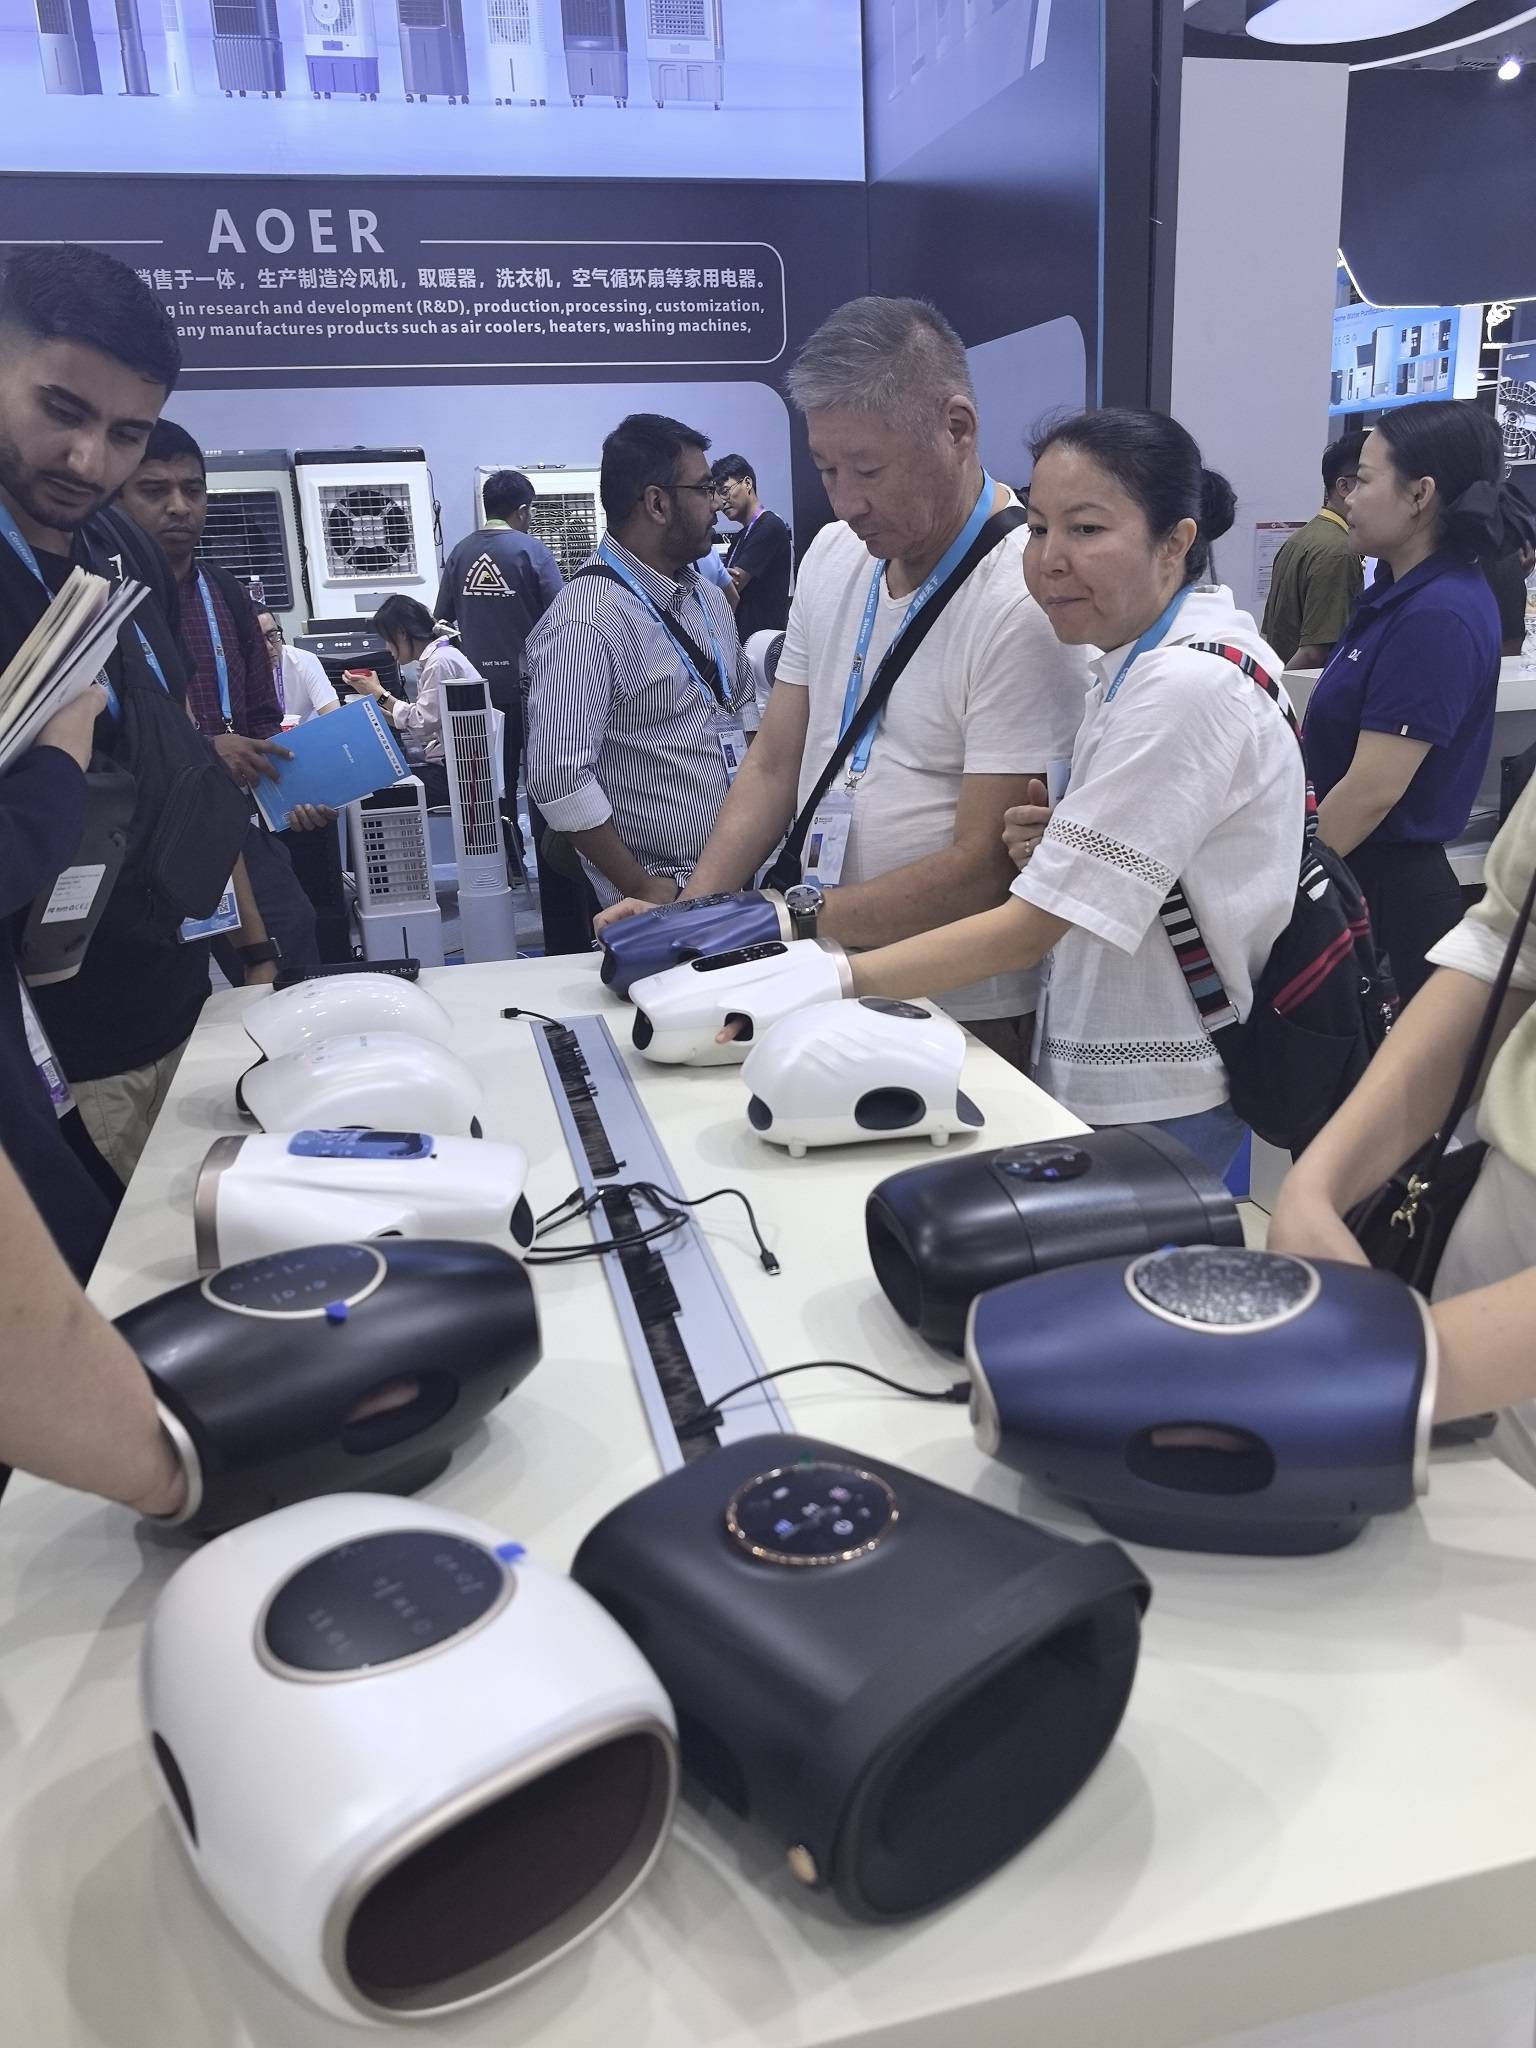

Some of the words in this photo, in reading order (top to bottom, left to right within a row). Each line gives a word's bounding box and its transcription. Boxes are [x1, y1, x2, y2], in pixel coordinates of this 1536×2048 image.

[207, 208, 385, 254] AOER
[178, 301, 196, 316] in
[199, 300, 270, 316] research
[273, 300, 303, 315] and
[307, 299, 414, 318] development
[416, 299, 471, 317] (R&D),
[655, 298, 765, 314] customization,
[210, 321, 324, 336] manufactures
[327, 320, 399, 339] products
[402, 320, 438, 334] such
[441, 323, 458, 334] as
[461, 319, 482, 334] air
[484, 319, 546, 335] coolers,
[549, 318, 611, 335] heaters,
[614, 318, 675, 336] washing
[678, 318, 752, 334] machines,
[866, 583, 878, 613] Global
[859, 618, 870, 643] Share
